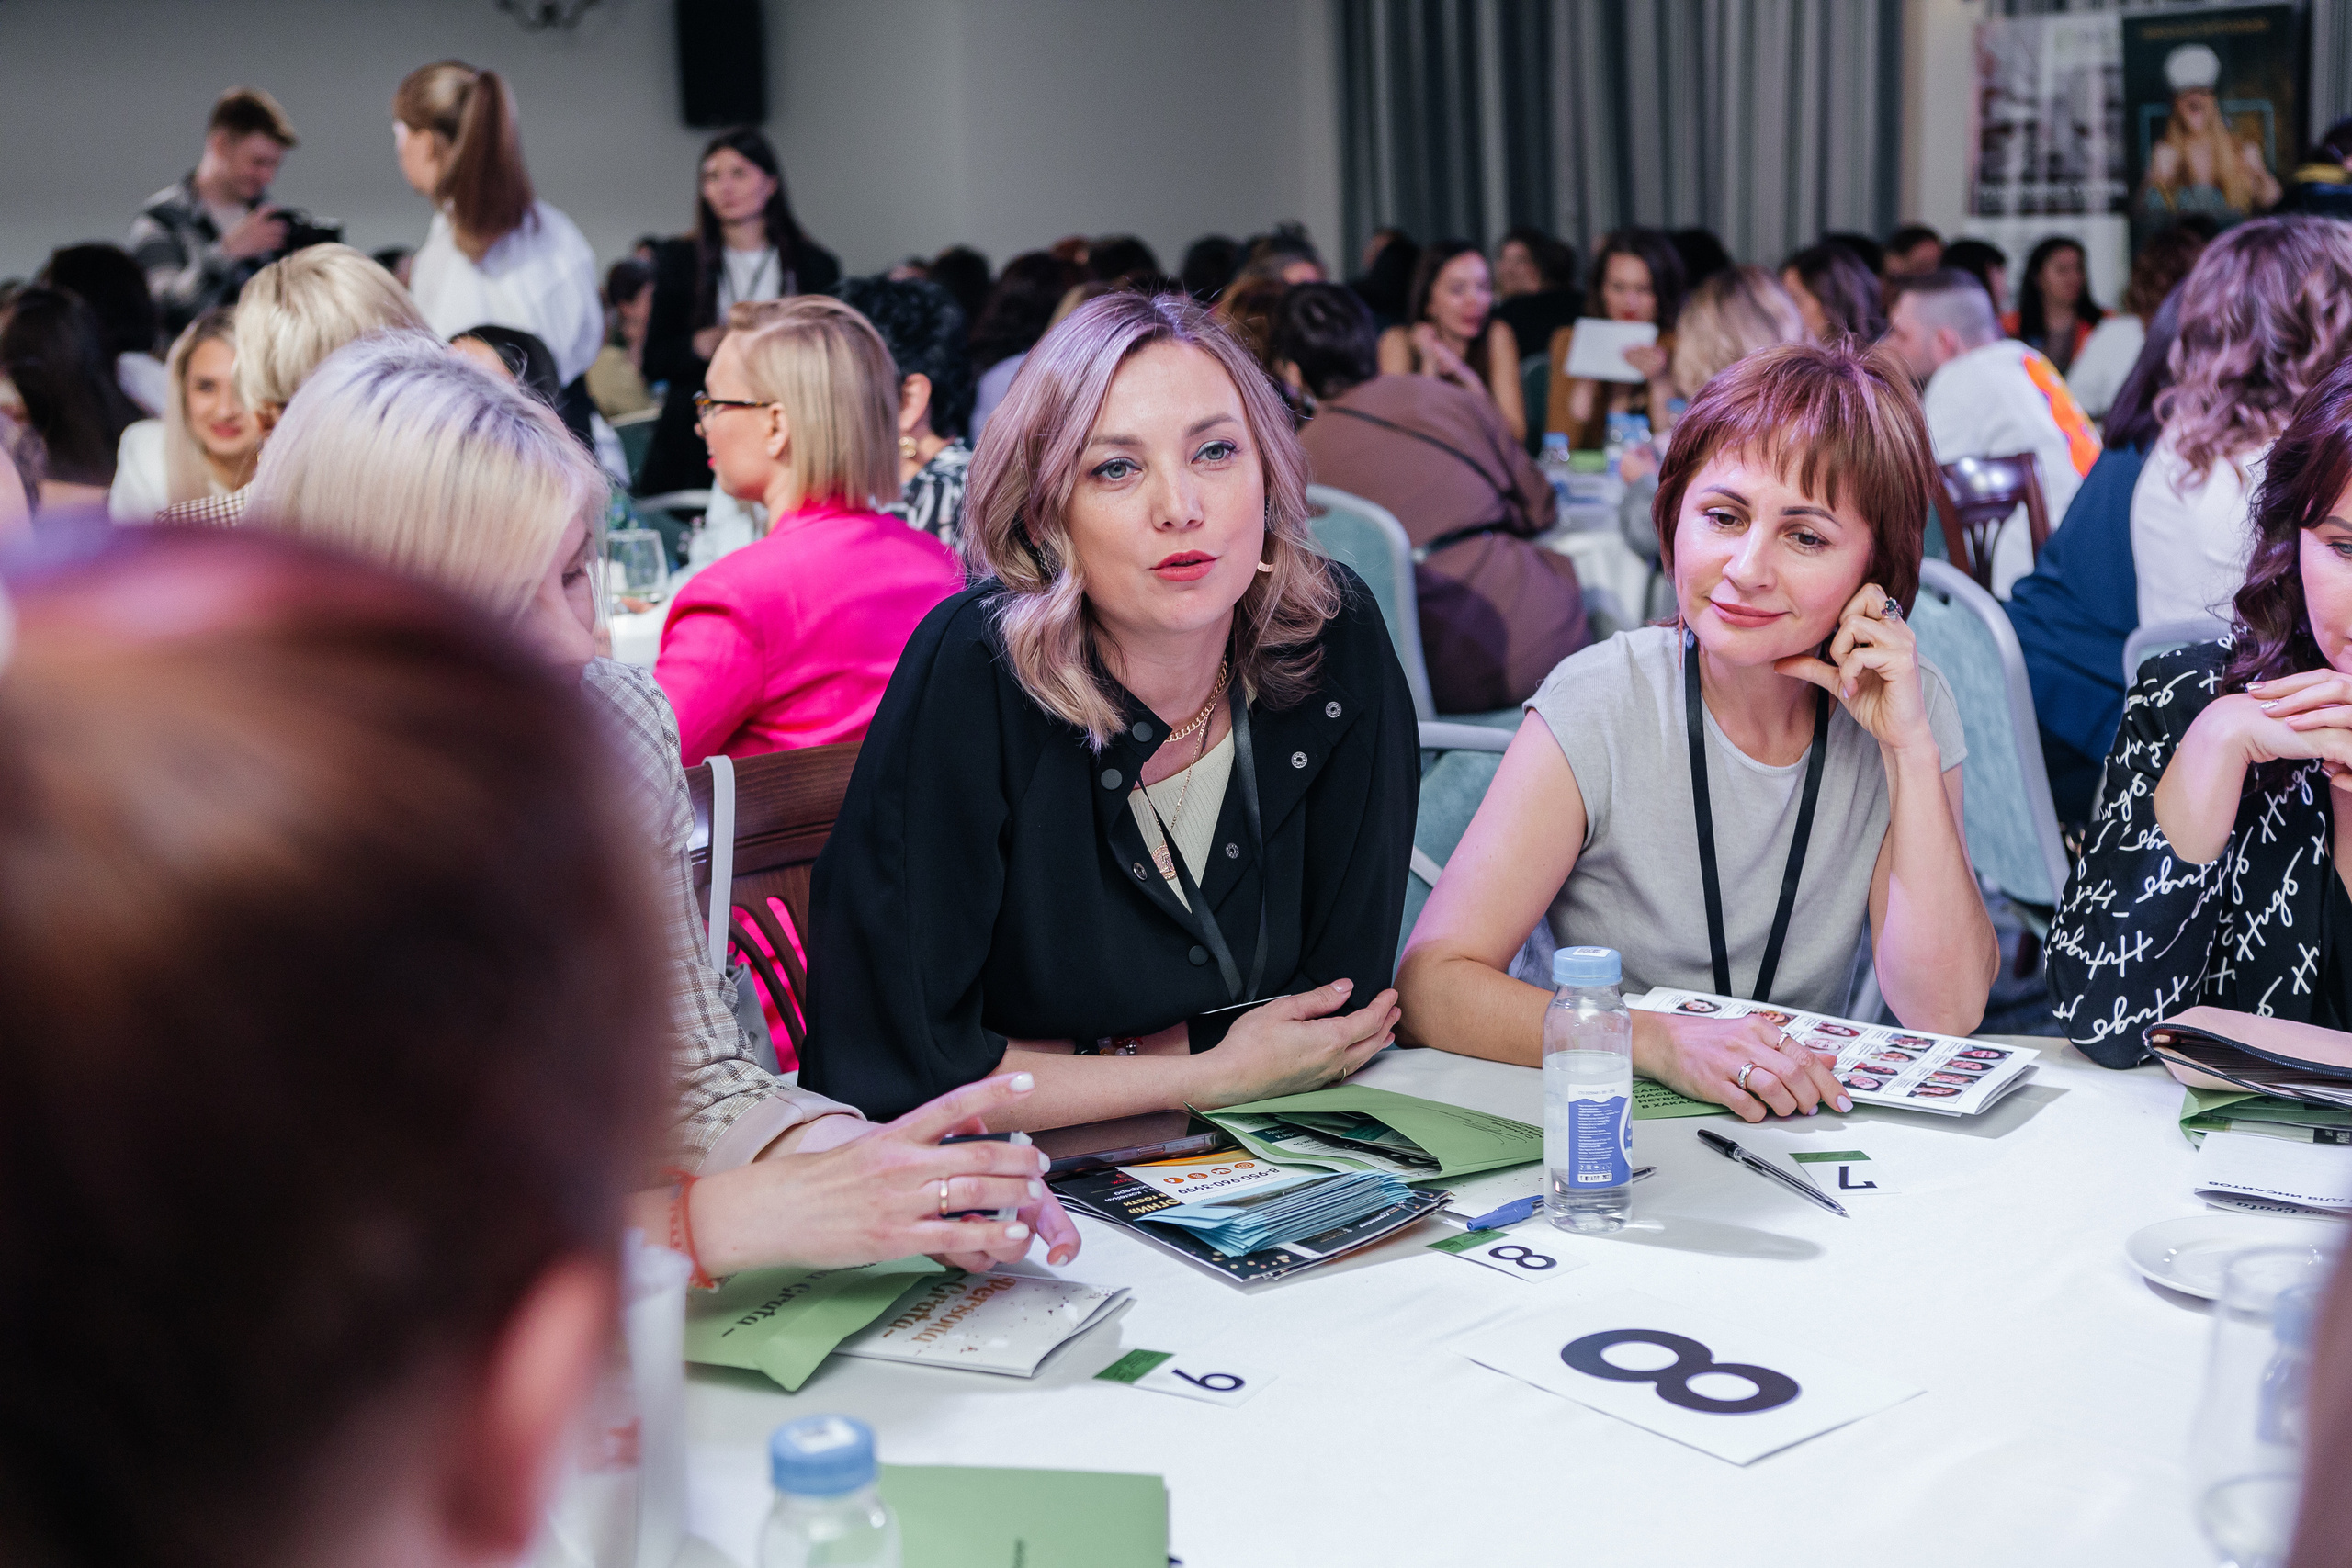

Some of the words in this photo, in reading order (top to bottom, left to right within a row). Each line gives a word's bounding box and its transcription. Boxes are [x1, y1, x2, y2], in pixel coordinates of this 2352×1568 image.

[2236, 847, 2304, 962] Hugo
[1653, 1100, 1696, 1108] ХАКАС
[1838, 1165, 1878, 1190] 7
[2208, 1181, 2302, 1198] ИНСАЙТОВ
[1488, 1245, 1557, 1270] 8
[736, 1282, 811, 1325] Grata
[911, 1277, 1017, 1342] Persona
[1560, 1327, 1803, 1416] 8
